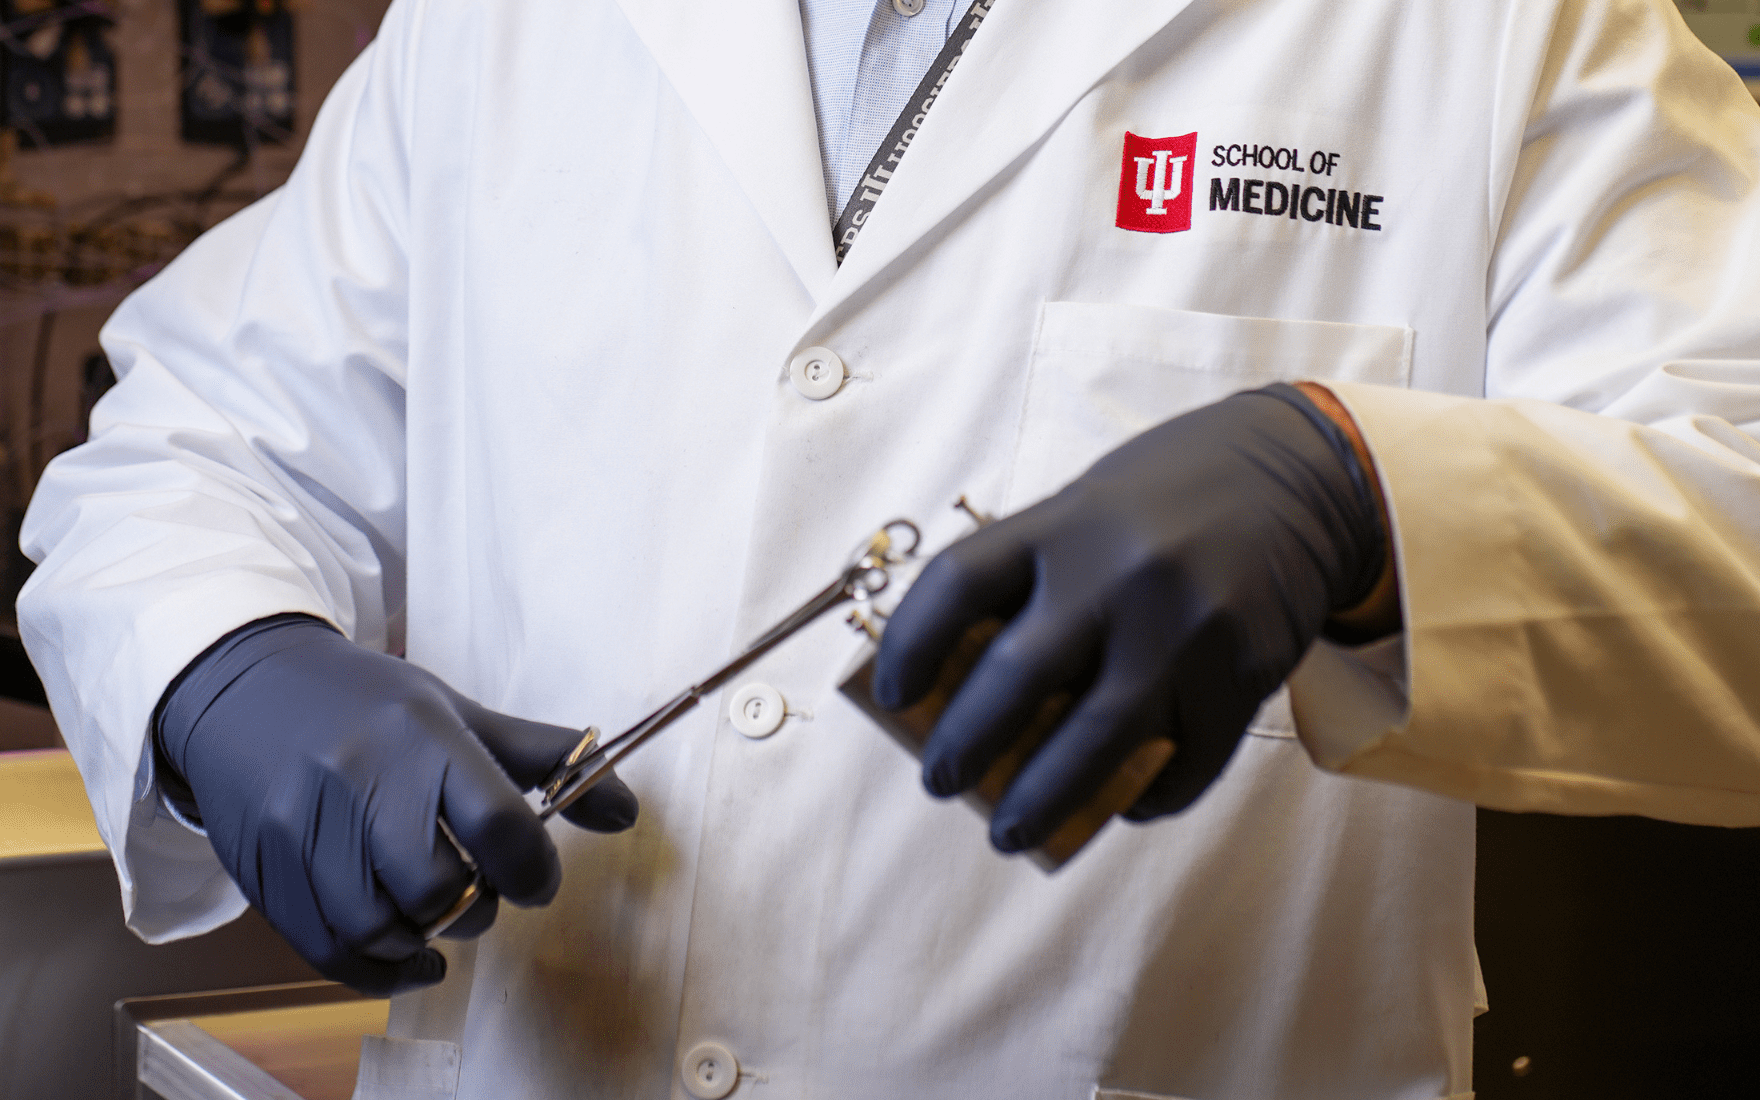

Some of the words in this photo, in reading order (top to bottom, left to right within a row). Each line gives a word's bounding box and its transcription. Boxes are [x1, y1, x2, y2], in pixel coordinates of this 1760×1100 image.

[1211, 143, 1305, 172] SCHOOL
[1309, 150, 1341, 176] OF
[1209, 177, 1384, 231] MEDICINE
